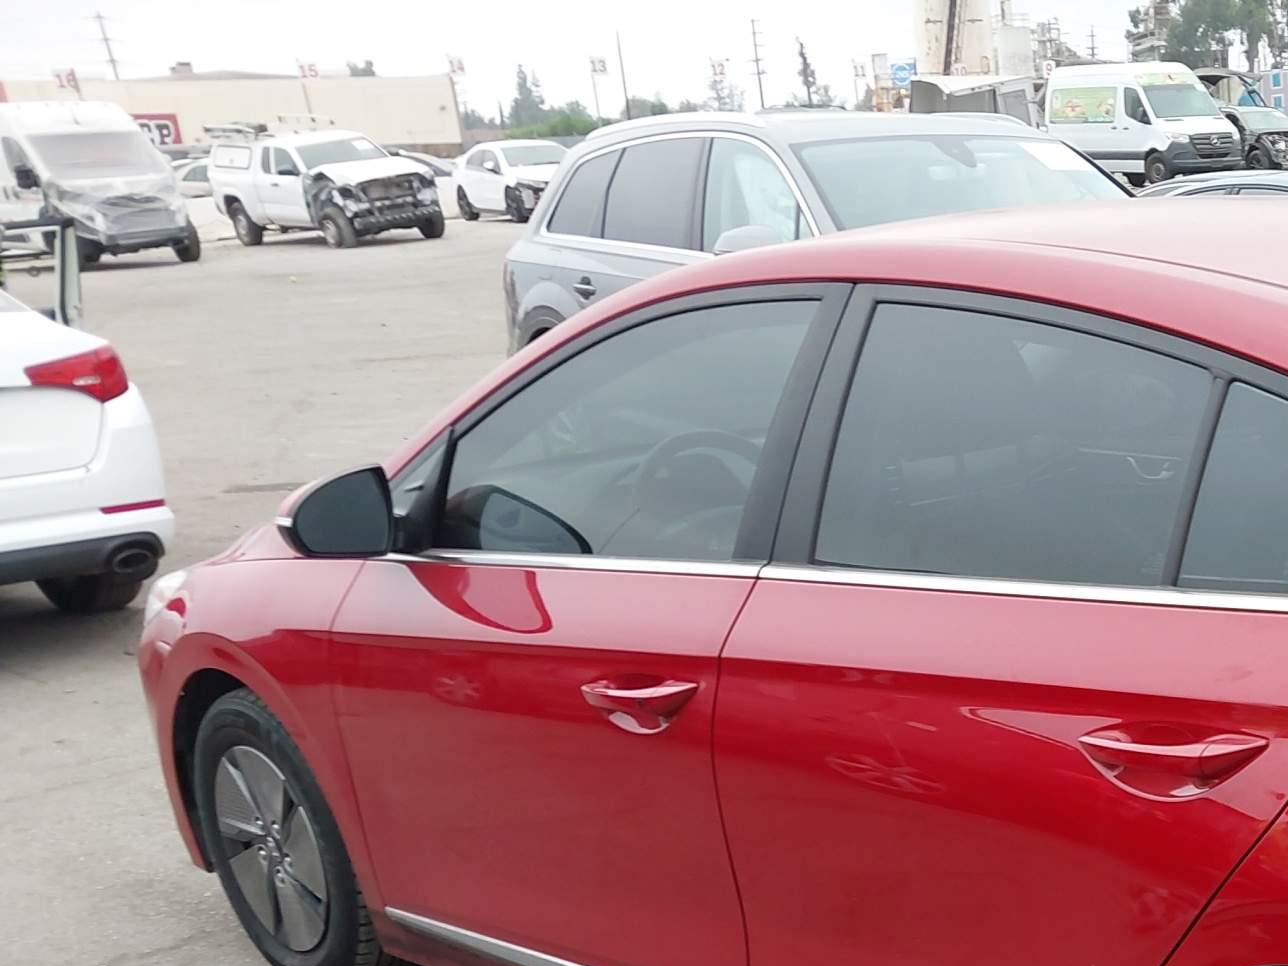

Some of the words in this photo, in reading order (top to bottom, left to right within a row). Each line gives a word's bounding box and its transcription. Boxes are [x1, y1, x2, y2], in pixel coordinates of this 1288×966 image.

[299, 64, 319, 78] 15
[590, 59, 607, 73] 13
[711, 63, 726, 76] 12
[853, 65, 866, 77] 11
[54, 71, 76, 88] 16
